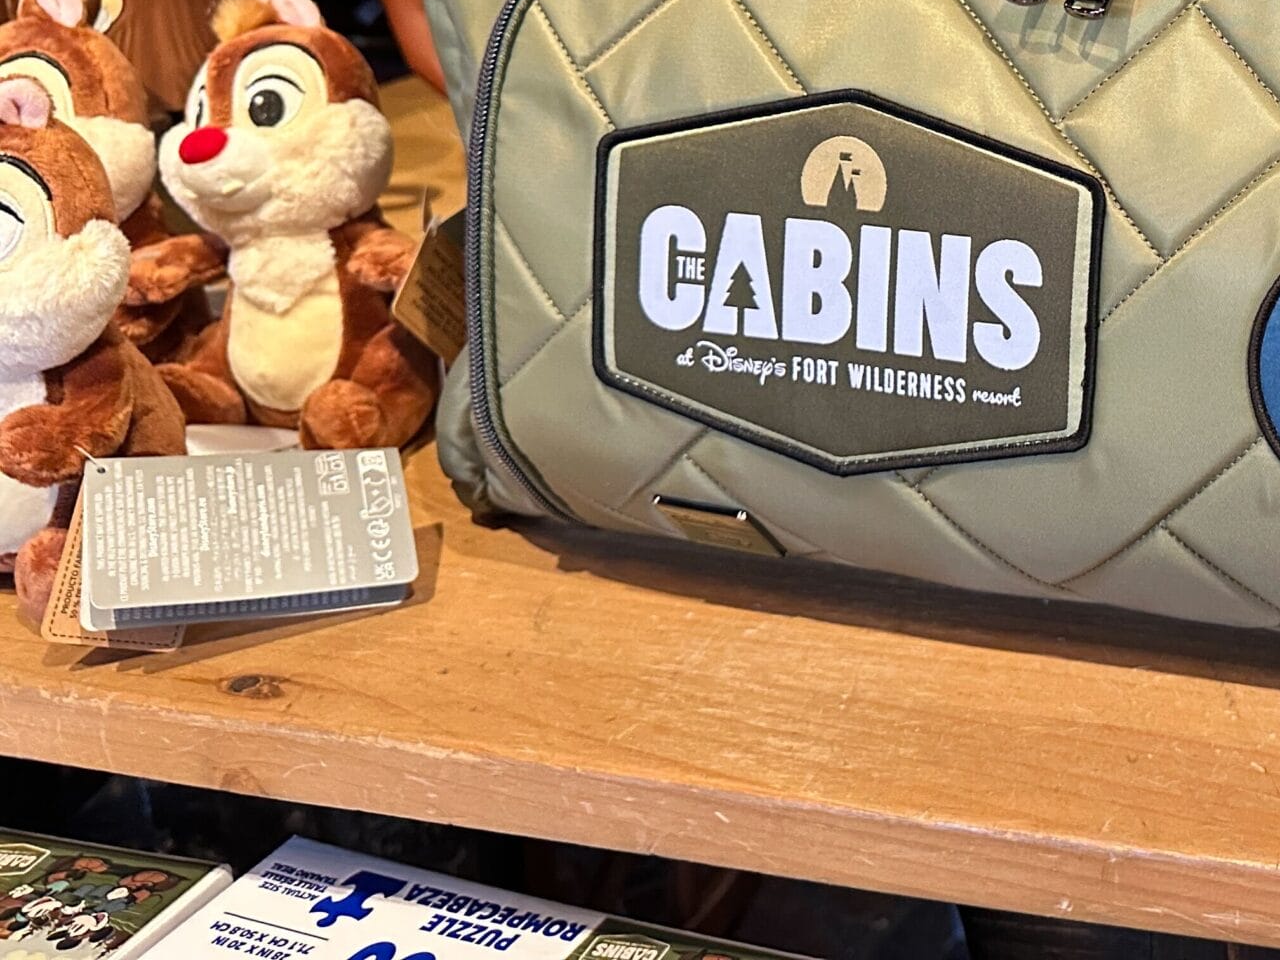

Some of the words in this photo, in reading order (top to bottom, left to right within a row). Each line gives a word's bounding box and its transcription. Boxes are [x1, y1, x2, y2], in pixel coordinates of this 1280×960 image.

[676, 254, 705, 281] THE
[639, 204, 1044, 371] CABINS
[676, 347, 695, 367] at
[696, 340, 787, 385] Disney's
[792, 356, 839, 386] FORT
[848, 363, 966, 404] WILDERNESS
[972, 387, 1022, 408] resort
[61, 569, 78, 614] PRODUCTO
[258, 880, 282, 892] SIZE
[282, 887, 319, 901] ACTUAL
[402, 883, 588, 942] ROMPECABEZA
[210, 921, 232, 932] CM
[228, 926, 259, 939] 50.8
[419, 913, 522, 951] PUZZLE
[211, 935, 230, 946] IN
[226, 939, 248, 950] 20
[255, 933, 270, 943] X
[267, 936, 289, 948] CM
[244, 944, 260, 955] X
[255, 947, 275, 959] IN
[288, 941, 315, 955] 71.1
[591, 942, 658, 960] CABINS
